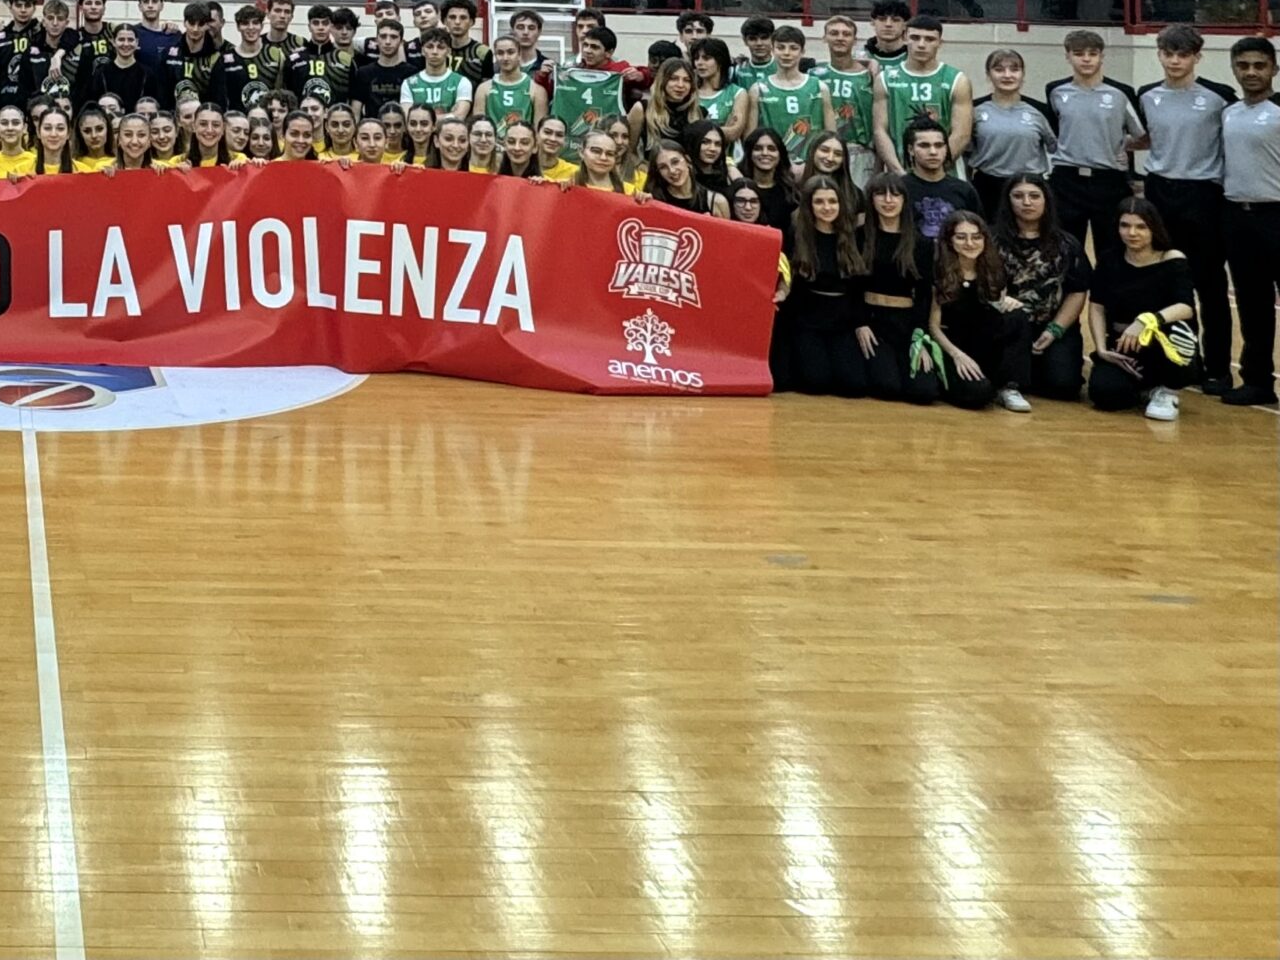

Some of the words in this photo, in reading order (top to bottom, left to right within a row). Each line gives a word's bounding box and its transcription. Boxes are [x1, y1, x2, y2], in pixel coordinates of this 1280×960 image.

[13, 38, 27, 53] 10
[92, 40, 107, 55] 16
[247, 64, 258, 79] 9
[309, 60, 325, 76] 18
[425, 87, 441, 103] 10
[503, 91, 513, 106] 5
[581, 88, 593, 105] 4
[910, 82, 932, 101] 13
[786, 96, 799, 114] 6
[48, 225, 142, 318] LA
[167, 216, 536, 333] VIOLENZA
[613, 262, 698, 302] VARESE
[608, 359, 704, 388] anemos
